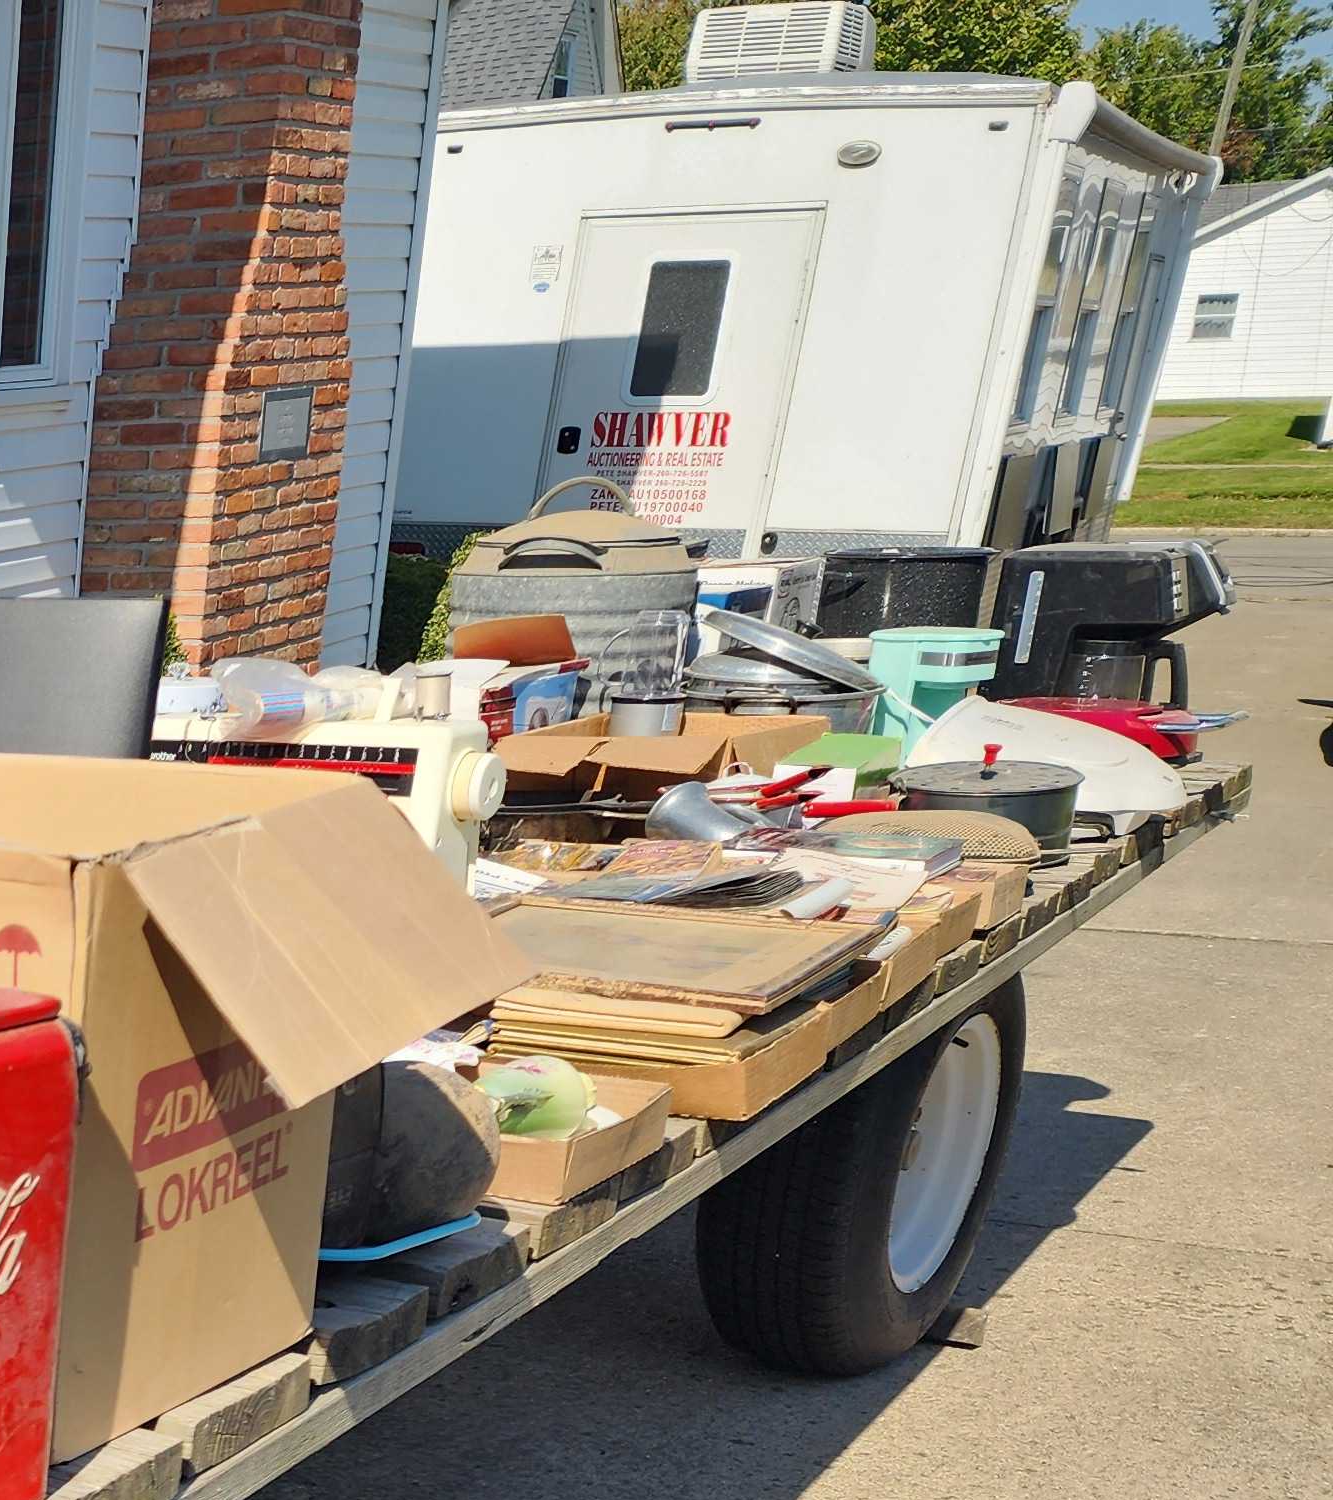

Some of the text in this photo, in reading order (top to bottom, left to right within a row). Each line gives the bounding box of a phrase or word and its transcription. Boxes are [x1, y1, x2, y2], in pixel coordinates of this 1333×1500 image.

[590, 411, 732, 448] SHAWVER
[587, 452, 655, 467] AUCTIONEERING
[665, 452, 689, 467] REAL
[691, 452, 724, 467] ESTATE
[635, 501, 703, 513] U19700040
[135, 1127, 289, 1243] LOKREEL
